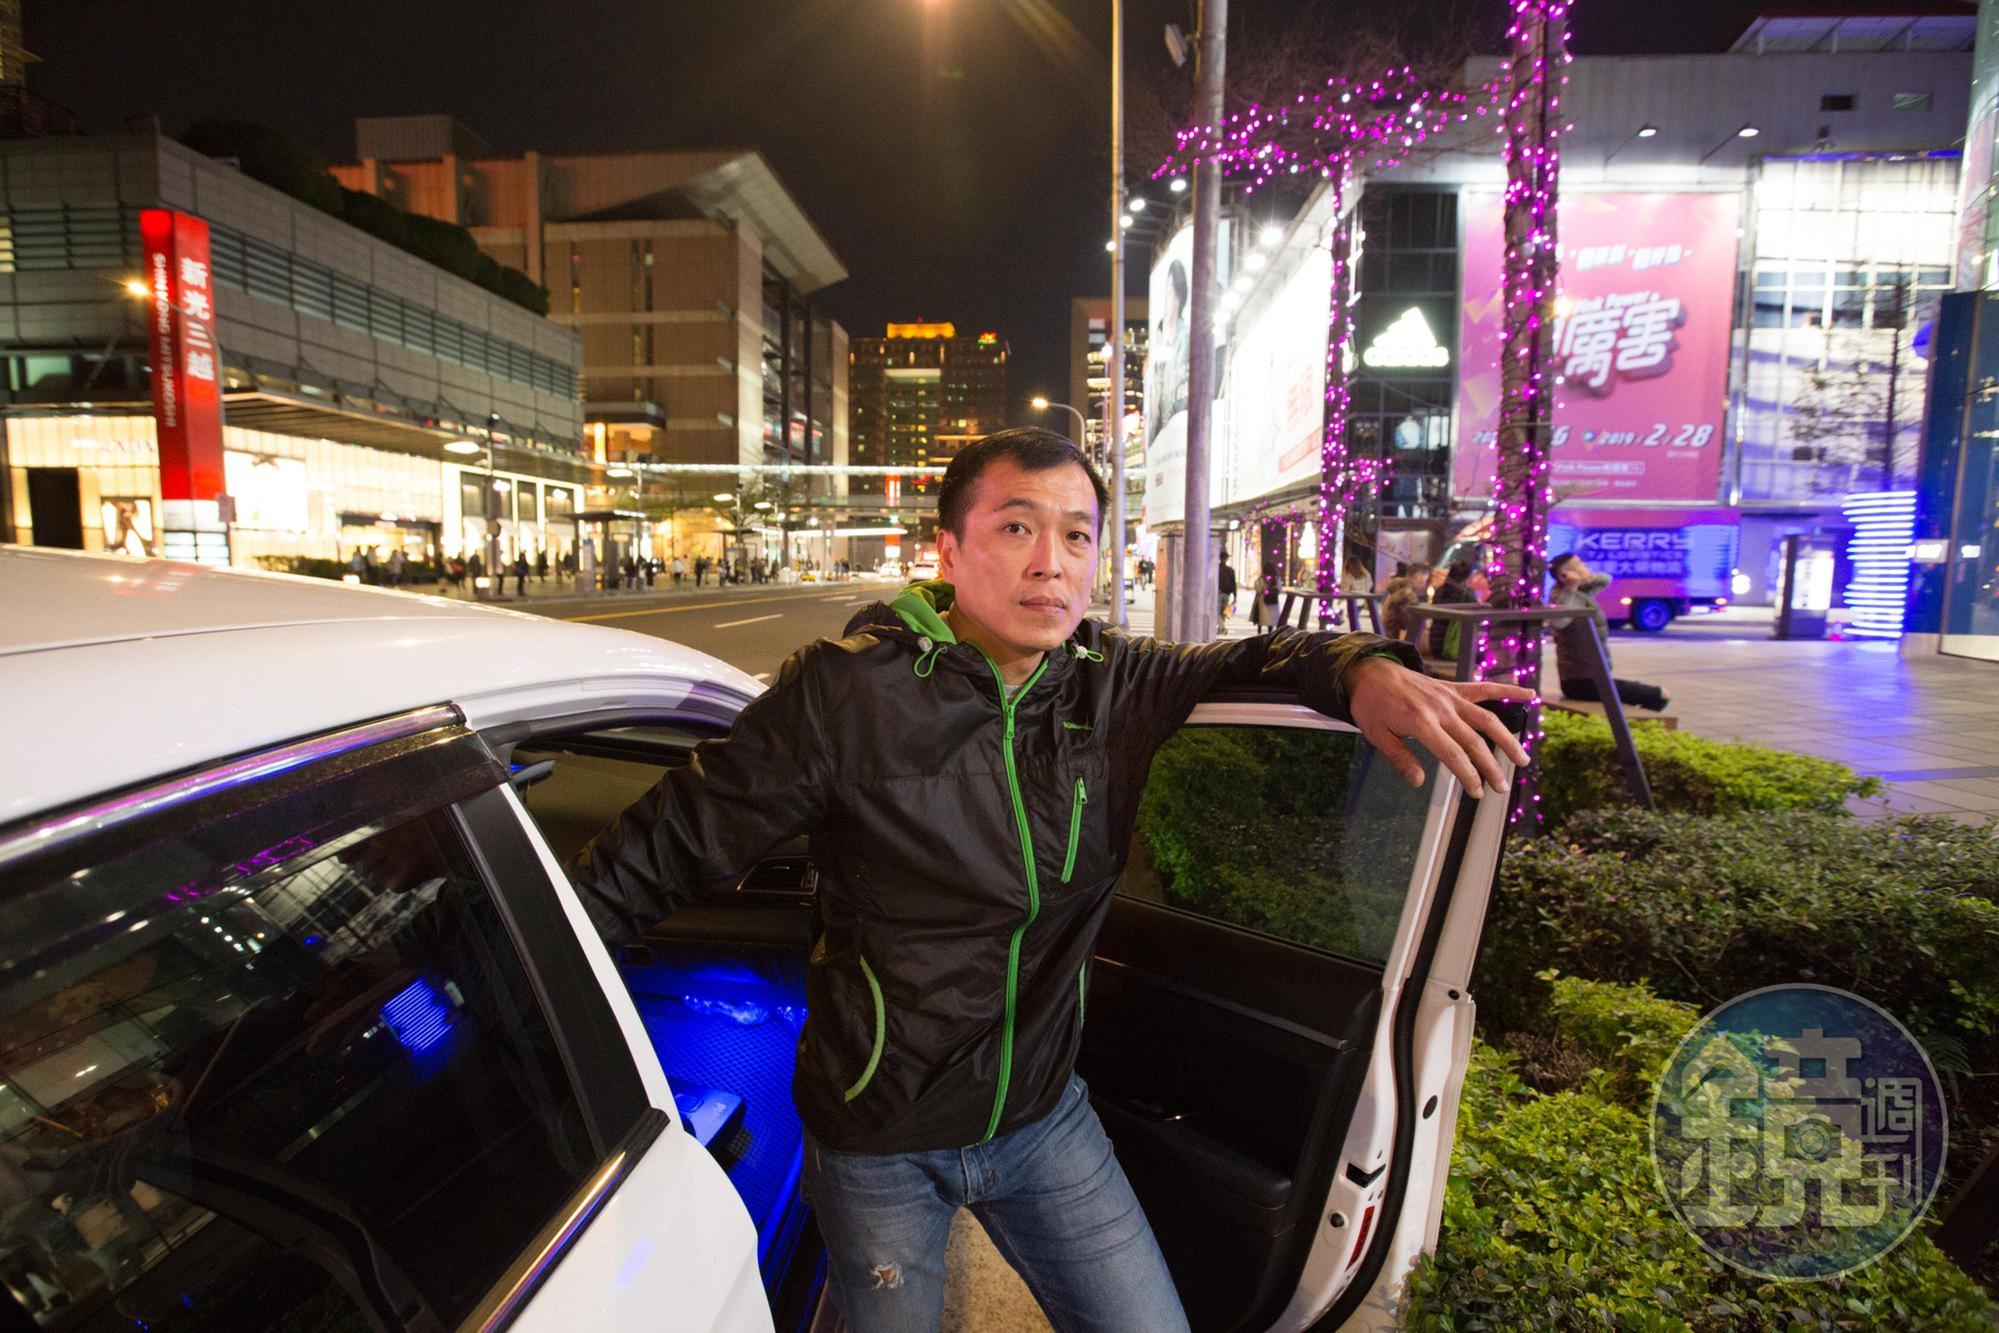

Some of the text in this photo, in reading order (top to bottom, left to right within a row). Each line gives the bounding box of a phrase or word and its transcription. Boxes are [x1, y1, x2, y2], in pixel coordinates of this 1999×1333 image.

[153, 252, 170, 334] SHINKONG
[180, 256, 214, 381] 新光三越
[1573, 532, 1694, 550] KERRY
